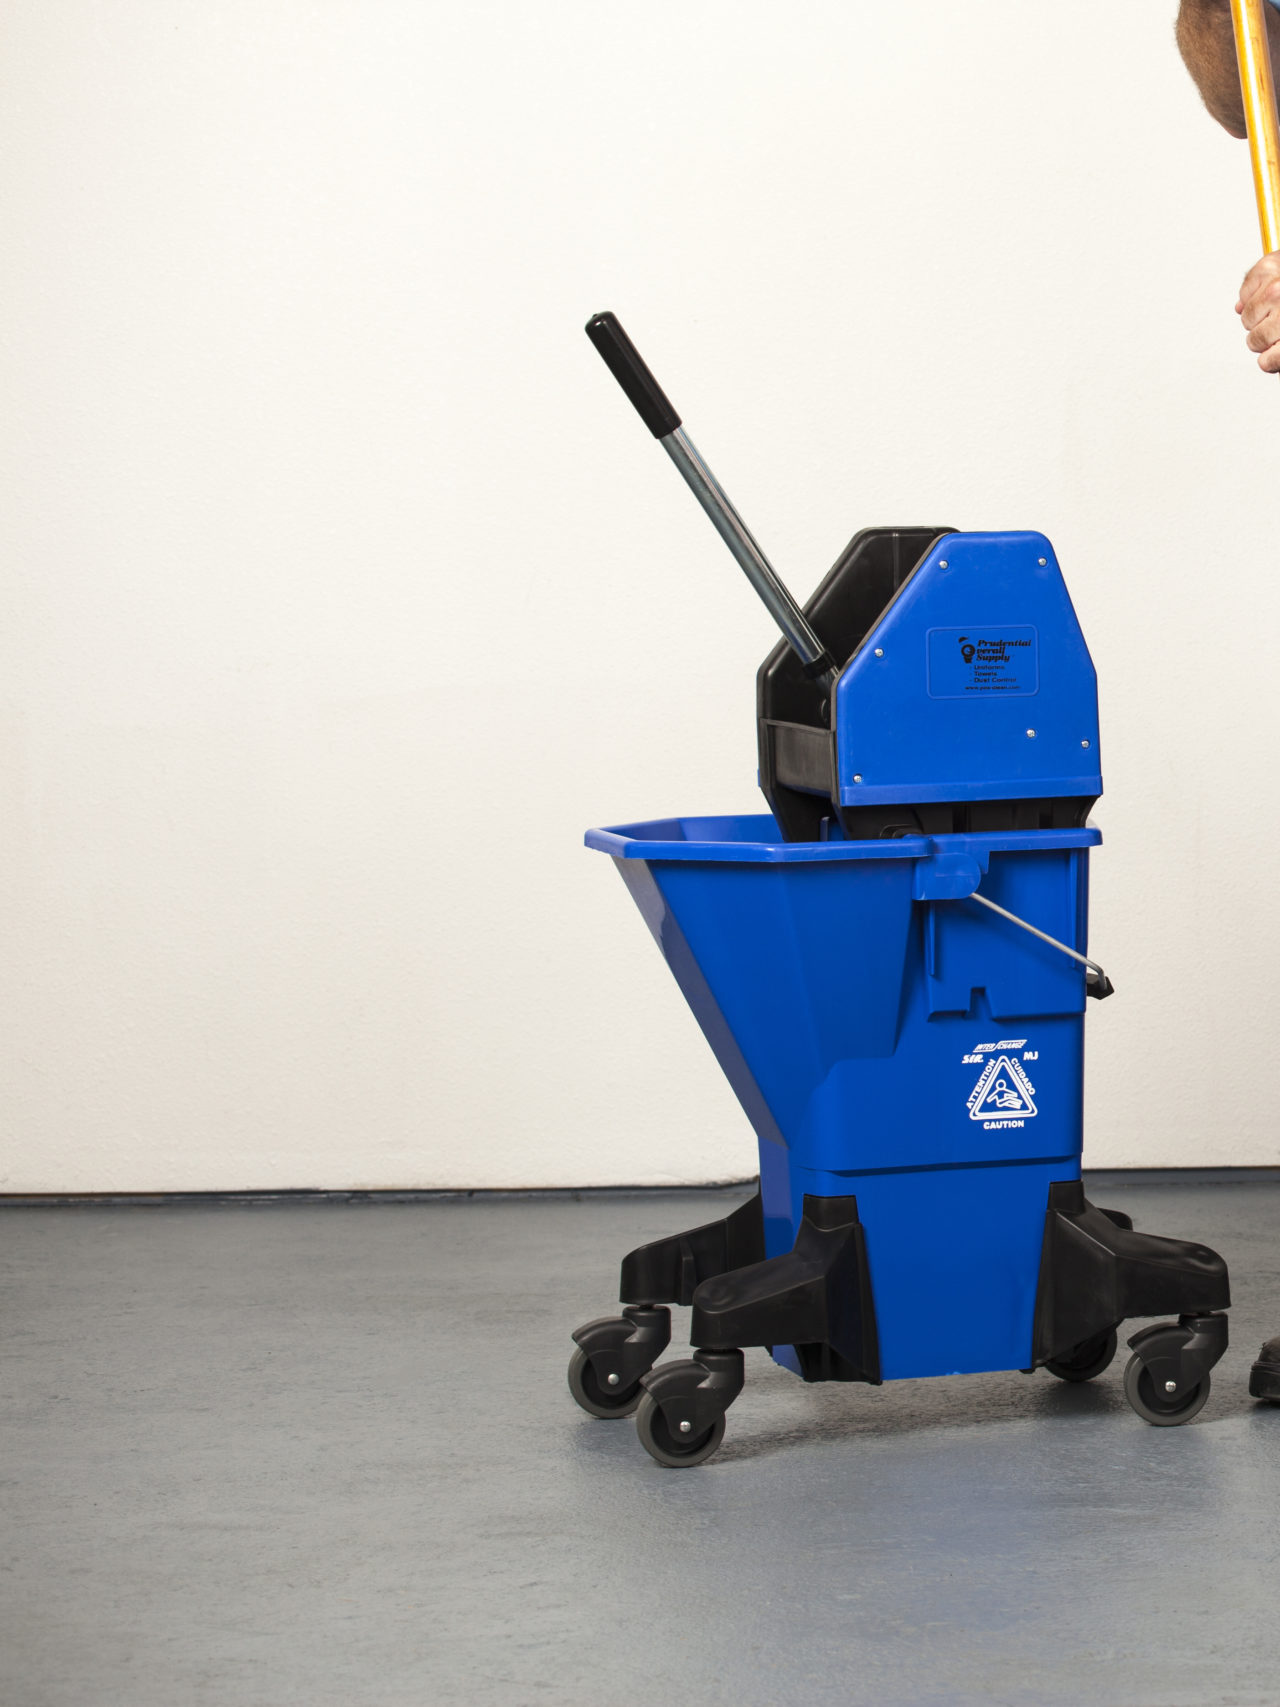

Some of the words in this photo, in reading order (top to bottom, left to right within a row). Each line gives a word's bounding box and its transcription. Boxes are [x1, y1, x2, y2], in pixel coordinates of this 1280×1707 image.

[977, 639, 1032, 647] Prudential
[976, 654, 1010, 662] Supply
[1011, 1057, 1036, 1096] CUIDADO
[966, 1058, 997, 1110] ATTENTION
[983, 1119, 1025, 1130] CAUTION
